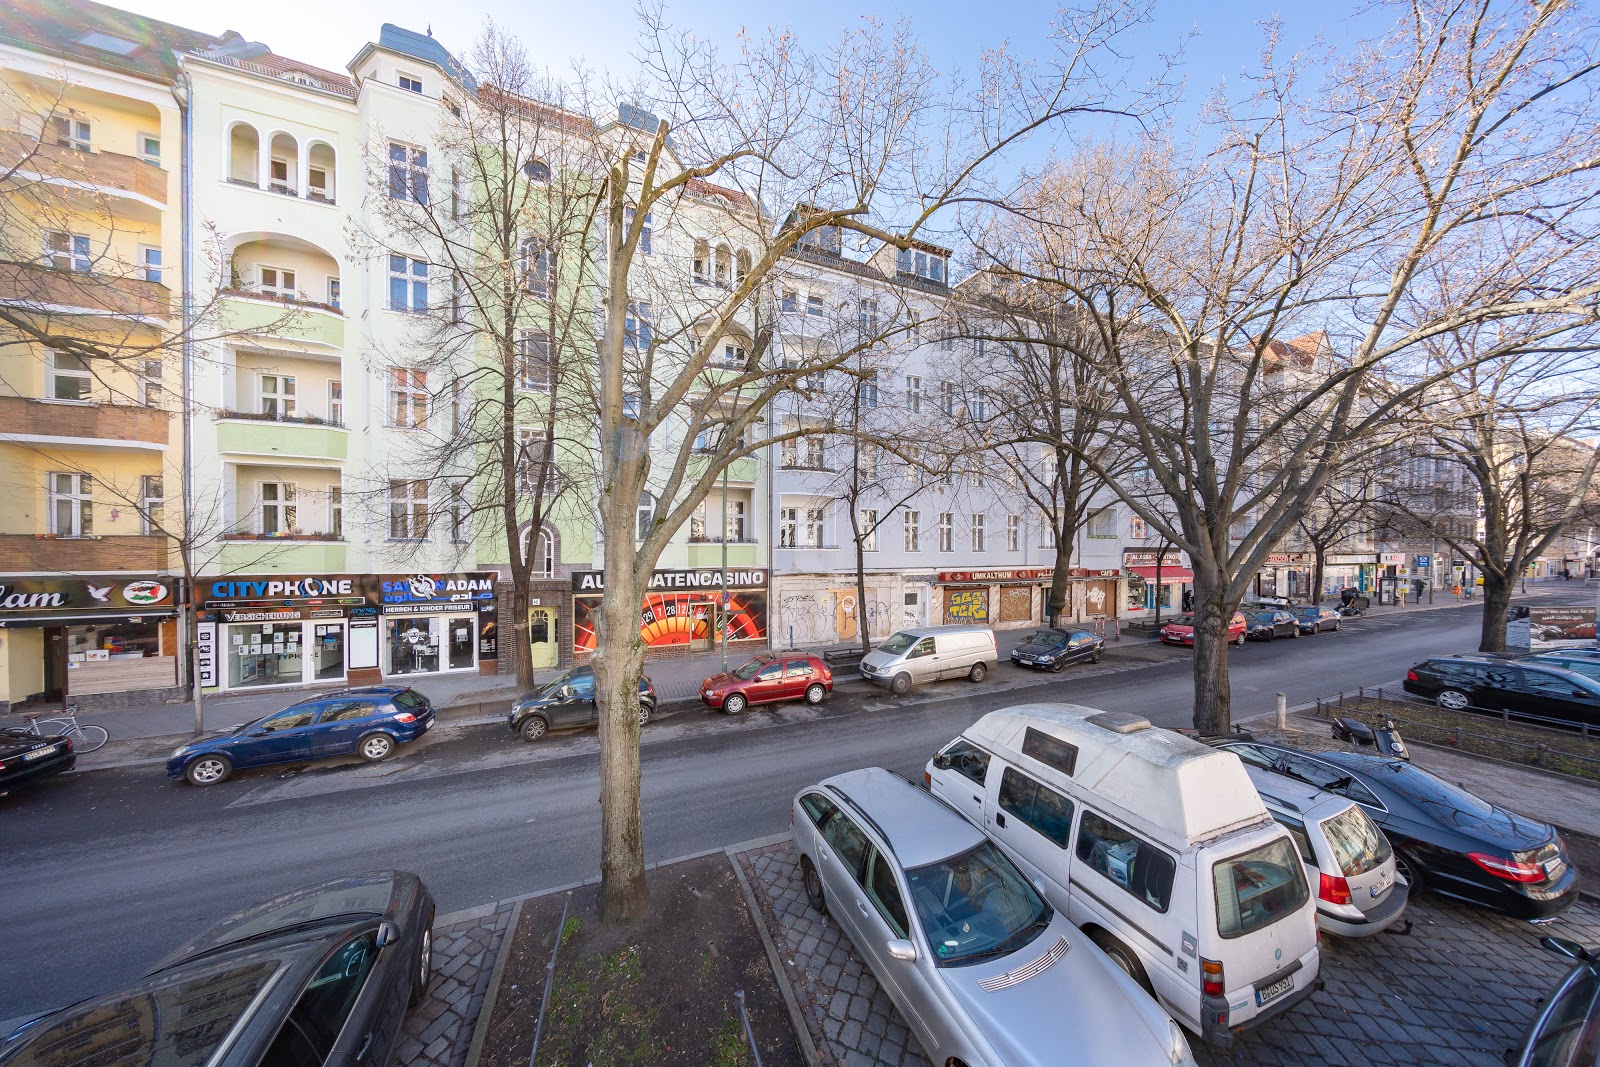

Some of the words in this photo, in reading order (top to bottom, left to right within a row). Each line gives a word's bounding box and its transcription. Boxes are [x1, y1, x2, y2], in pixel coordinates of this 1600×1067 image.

[580, 571, 764, 589] AUATENCASINO
[972, 571, 1012, 580] UMKALTHUM
[212, 579, 352, 597] CITYPHONE
[446, 579, 492, 591] ADAM
[666, 606, 676, 615] 28
[677, 604, 686, 615] 12
[225, 611, 301, 621] VERSICHERUNG
[643, 611, 653, 622] 29
